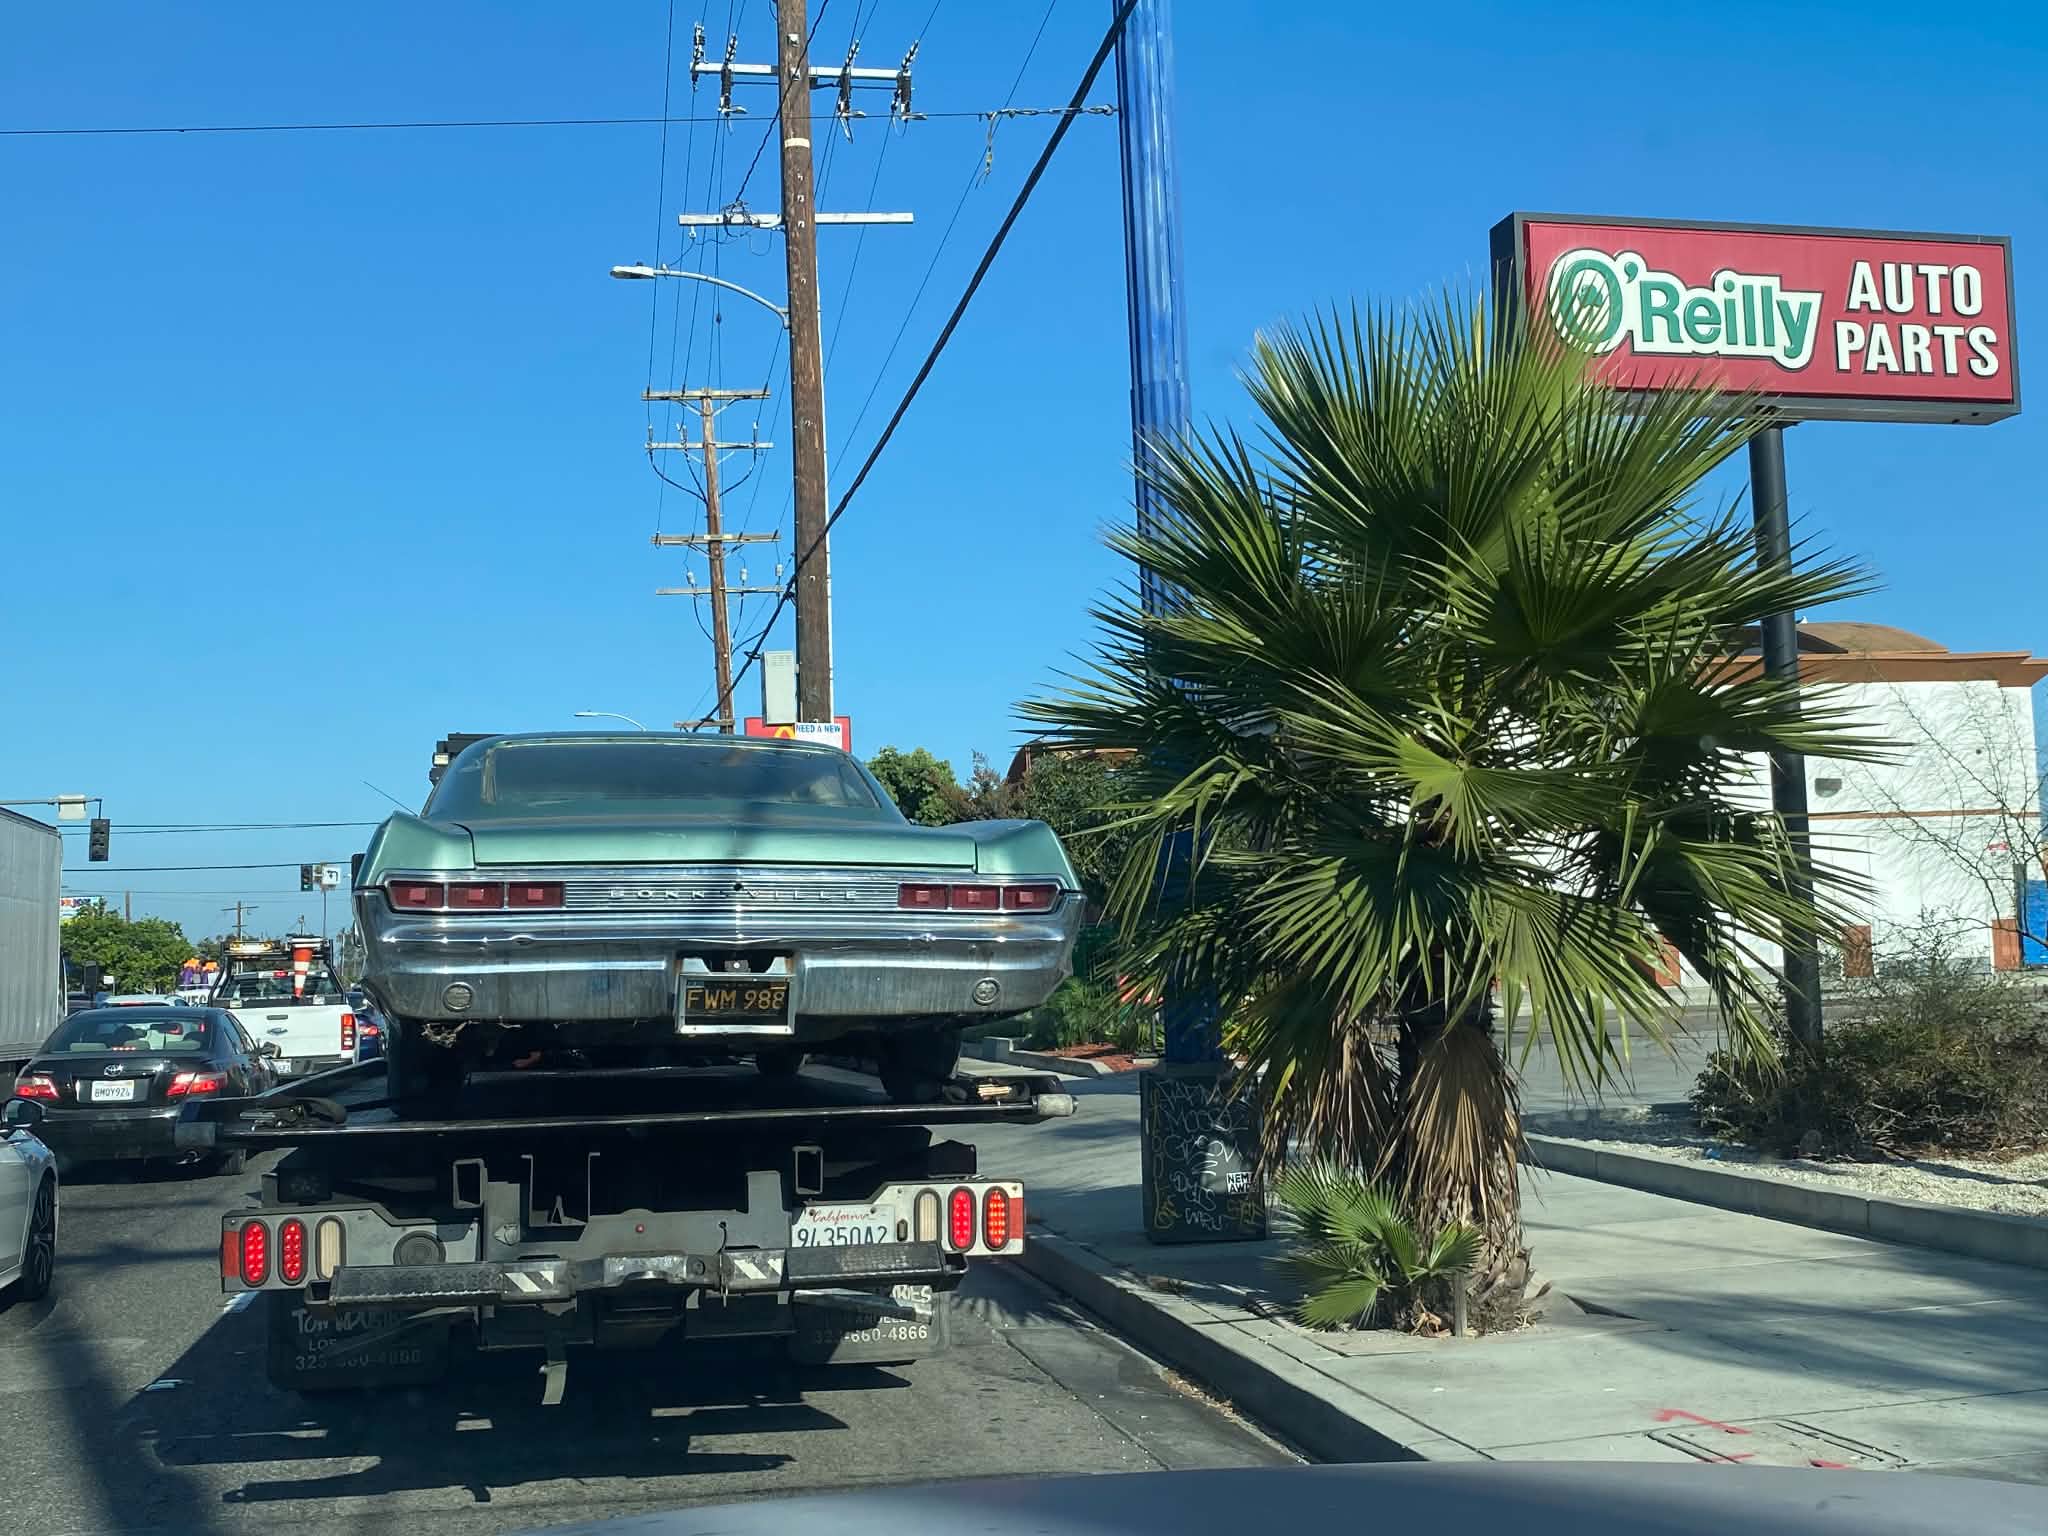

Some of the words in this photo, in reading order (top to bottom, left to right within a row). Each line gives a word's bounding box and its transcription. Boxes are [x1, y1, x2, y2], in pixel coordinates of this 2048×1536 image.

[1553, 250, 1822, 369] O'Reilly
[1848, 261, 1983, 317] AUTO
[1836, 321, 1999, 378] PARTS
[796, 724, 815, 733] NEED
[817, 724, 822, 733] A
[824, 724, 841, 733] NEW
[687, 989, 737, 1009] FWM
